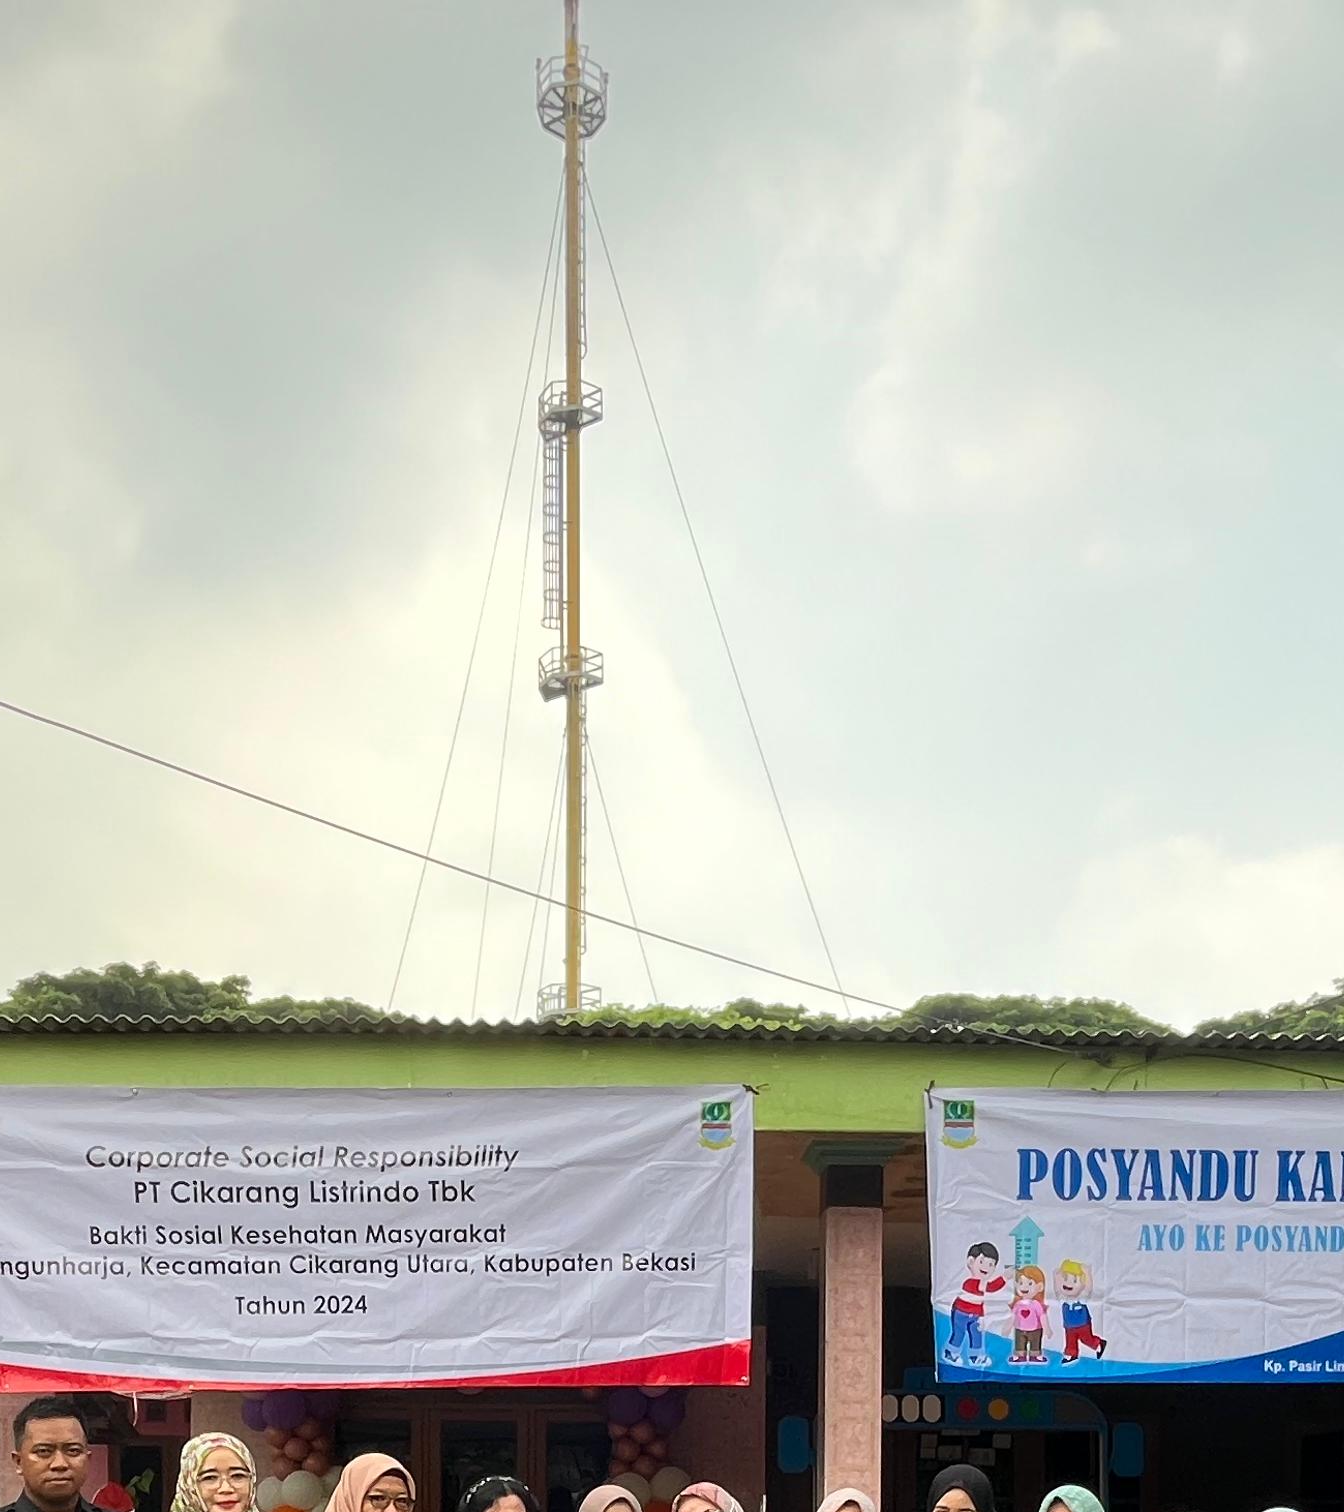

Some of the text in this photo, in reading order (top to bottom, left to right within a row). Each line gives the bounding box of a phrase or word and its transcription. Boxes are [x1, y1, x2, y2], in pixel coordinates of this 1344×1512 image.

[85, 1144, 520, 1173] Corporate Social Responsibility
[1016, 1147, 1259, 1202] POSYANDU
[134, 1179, 476, 1208] PT Cikarang Listrindo Tbk
[89, 1222, 507, 1248] Bakti Sosial Kesehatan Masyarakat
[1137, 1223, 1185, 1252] AYO
[1194, 1224, 1226, 1252] KE
[141, 1254, 281, 1276] Kecamatan
[289, 1253, 399, 1278] Cikarang
[407, 1253, 475, 1276] Utara,
[483, 1252, 613, 1277] Kabupaten
[622, 1251, 697, 1273] Bekasi
[235, 1294, 368, 1316] Tahun 2024
[1263, 1359, 1286, 1374] Kp.
[1288, 1359, 1322, 1373] Pasir
